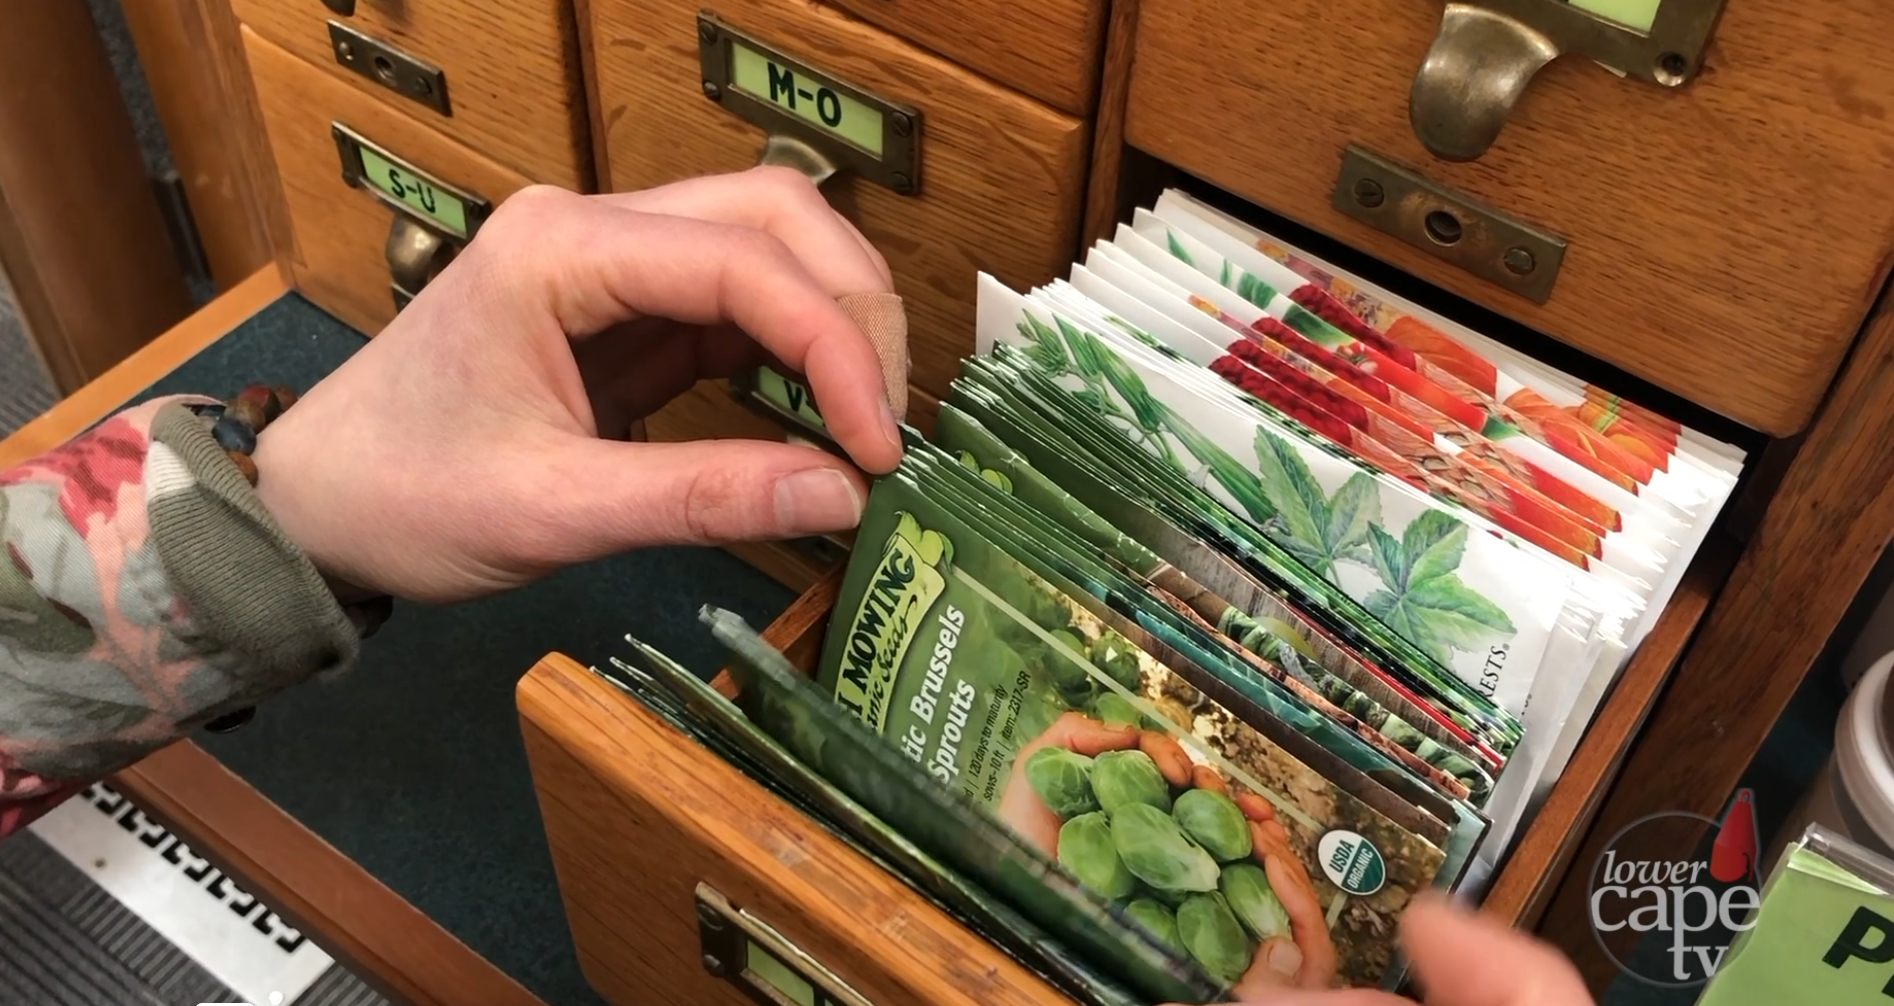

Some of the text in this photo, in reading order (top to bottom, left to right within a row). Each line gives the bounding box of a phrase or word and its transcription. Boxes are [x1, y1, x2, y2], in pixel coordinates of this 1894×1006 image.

[767, 62, 842, 128] M-O
[389, 168, 435, 213] S-U
[842, 548, 915, 696] MOWING
[877, 594, 918, 683] Seeds
[902, 604, 965, 764] tic Brussels
[986, 684, 1008, 729] maturity
[1008, 670, 1031, 716] 2317-SR
[927, 679, 976, 785] Sprouts
[973, 736, 989, 763] days
[982, 726, 992, 739] to
[969, 759, 982, 778] 120
[1329, 839, 1354, 873] USDA
[1347, 848, 1373, 889] ORGANIC
